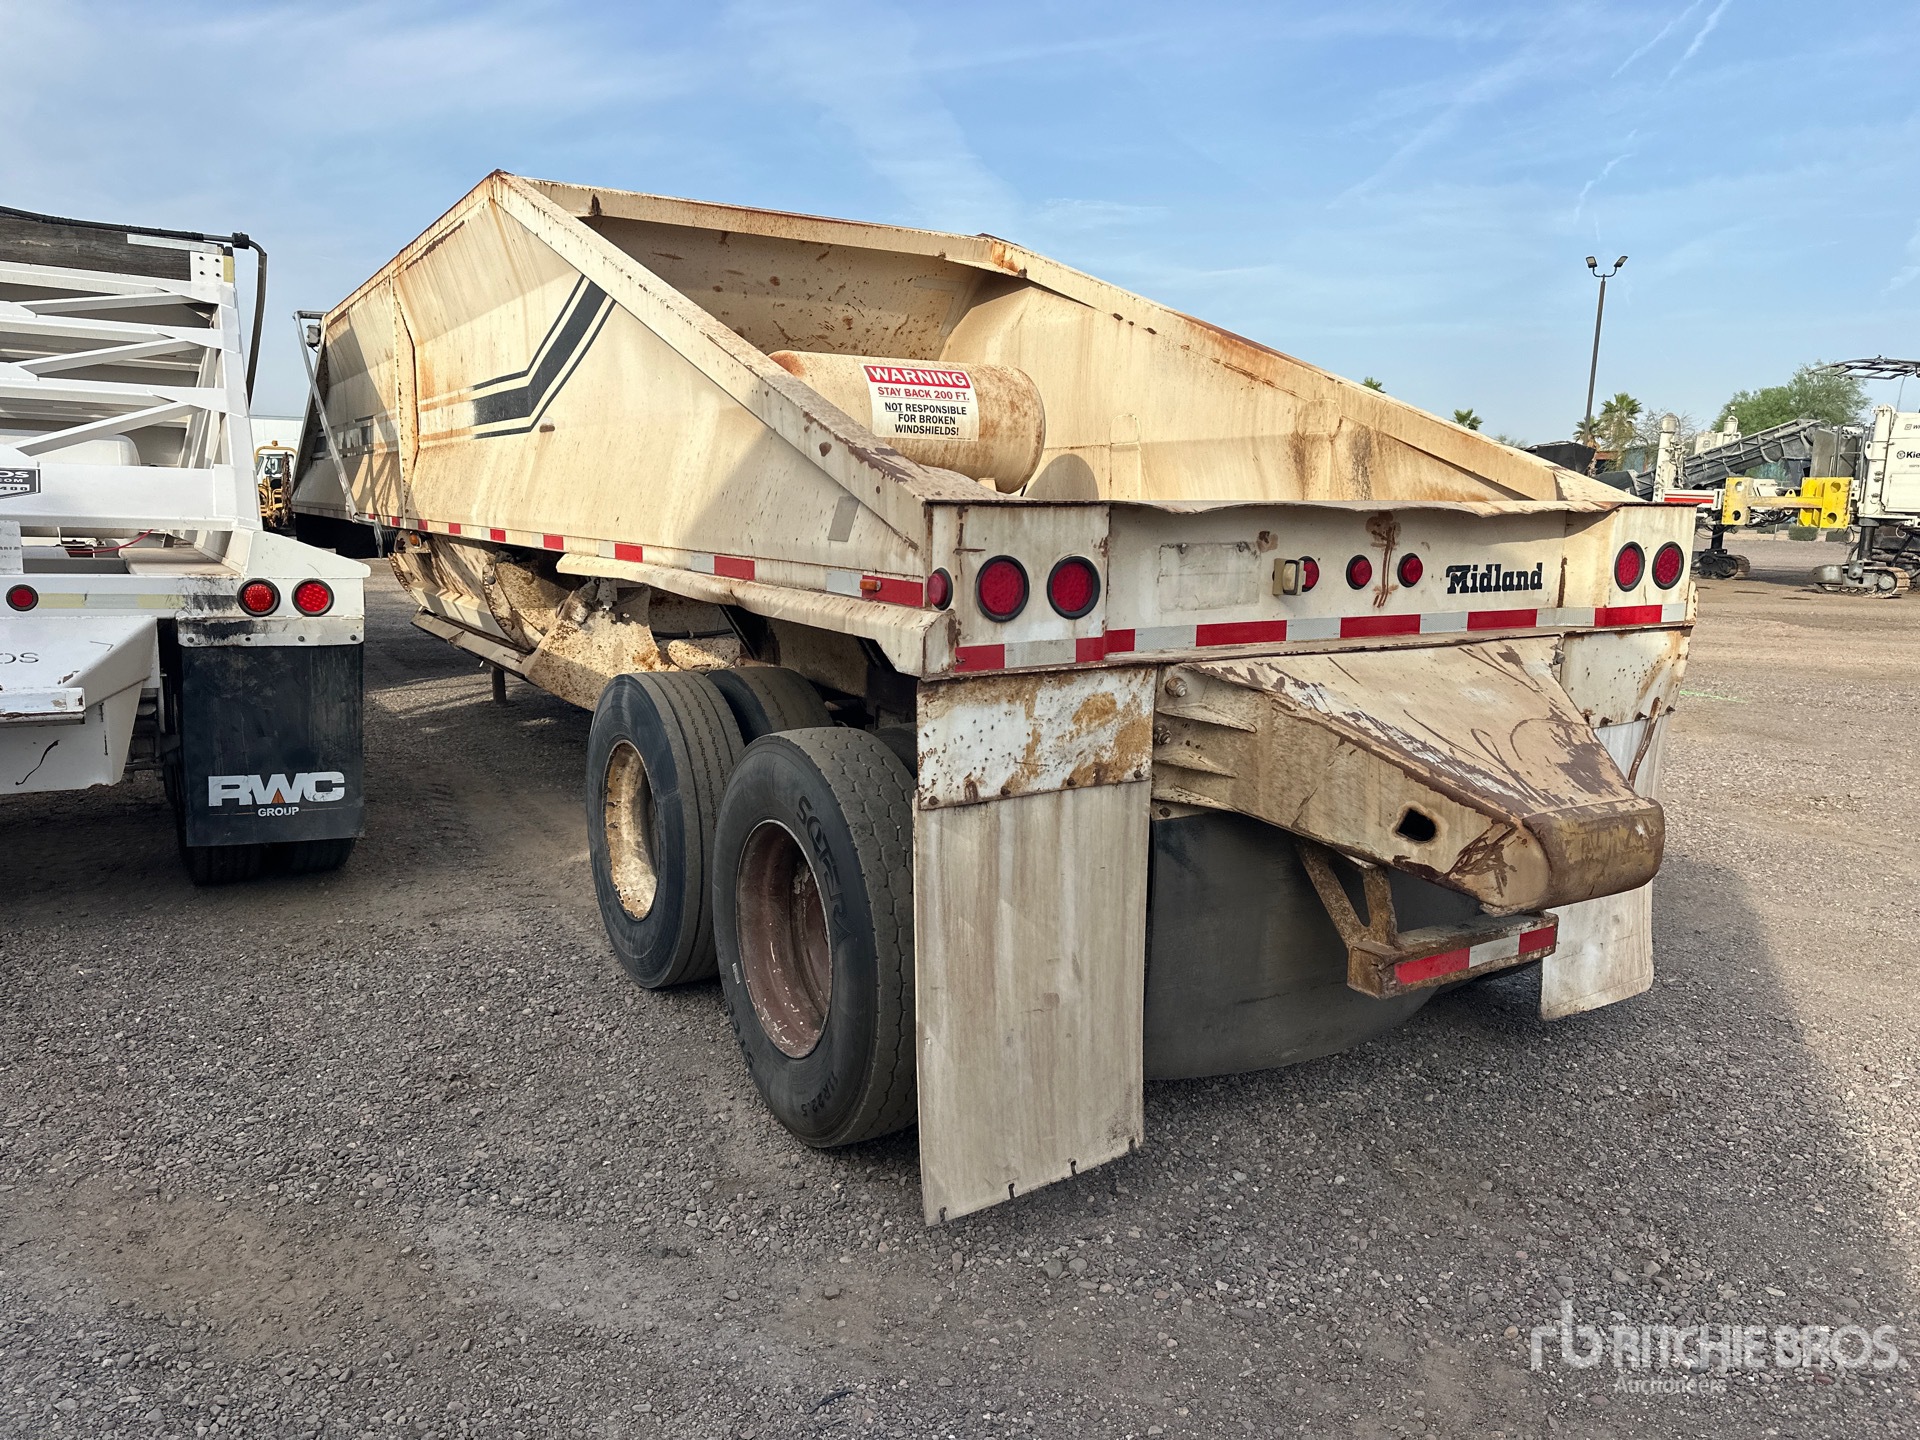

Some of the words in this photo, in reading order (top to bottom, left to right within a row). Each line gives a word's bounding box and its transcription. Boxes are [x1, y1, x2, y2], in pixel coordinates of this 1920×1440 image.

[868, 366, 967, 387] WARNING
[878, 387, 901, 397] STAY
[904, 388, 932, 399] BACK
[934, 389, 953, 400] 200
[955, 391, 970, 401] FT.
[884, 402, 903, 411] NOT
[905, 403, 967, 415] RESPONSIBLE
[898, 413, 917, 423] FOR
[919, 414, 956, 425] BROKEN
[894, 424, 959, 435] WINDSHIELDS!
[1445, 562, 1543, 594] Midland
[207, 771, 345, 807] RWC
[257, 806, 300, 817] GROUP
